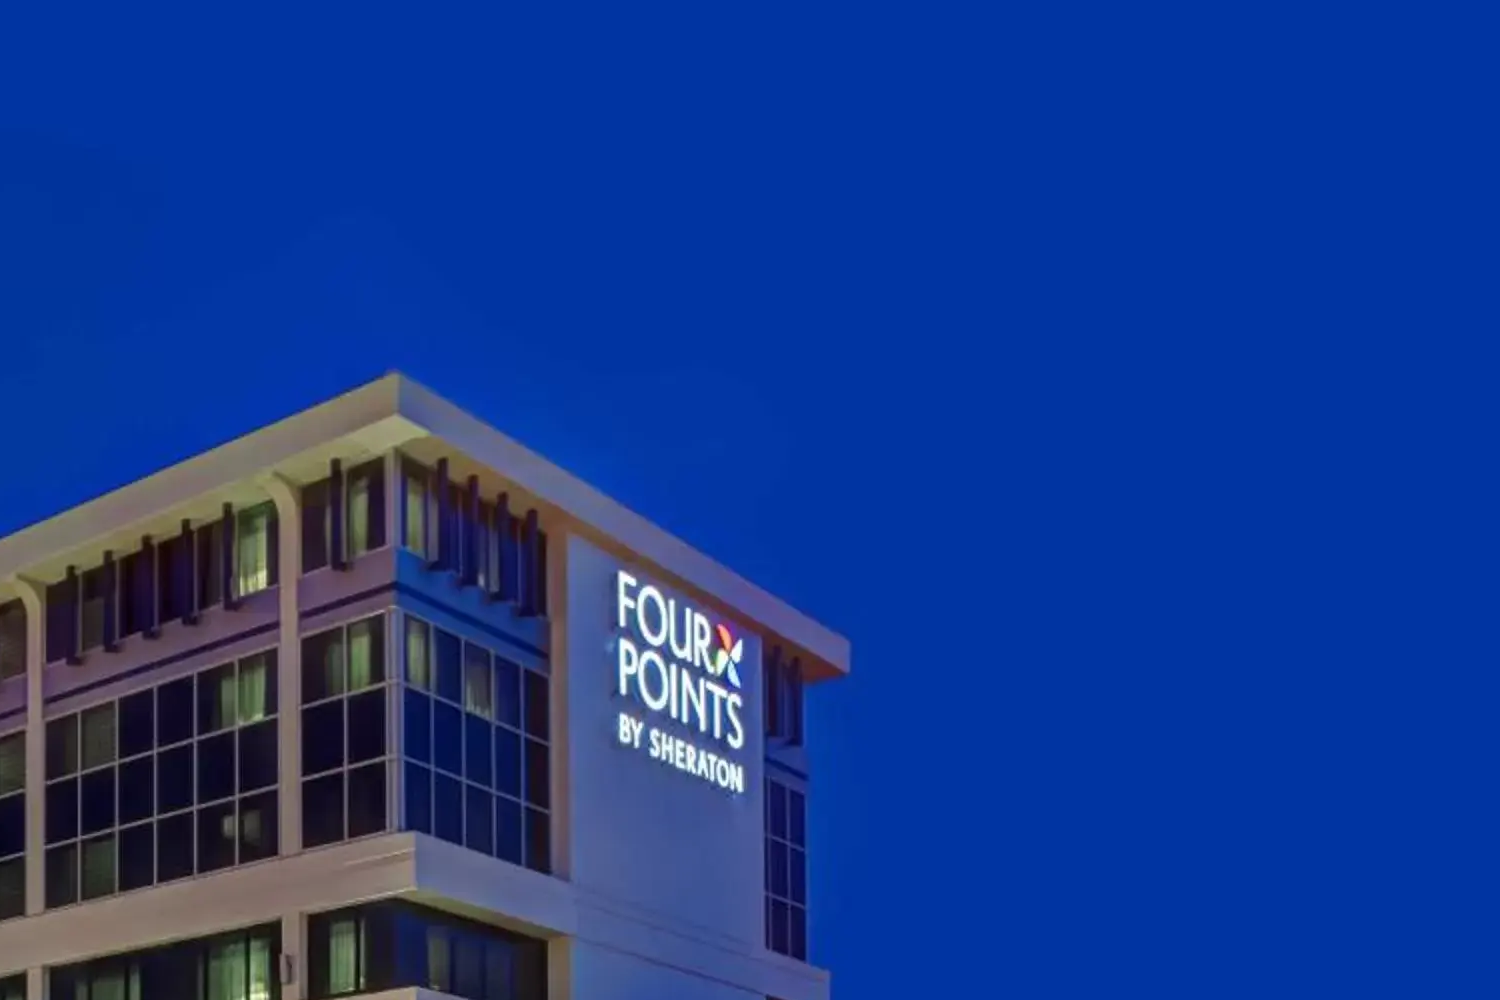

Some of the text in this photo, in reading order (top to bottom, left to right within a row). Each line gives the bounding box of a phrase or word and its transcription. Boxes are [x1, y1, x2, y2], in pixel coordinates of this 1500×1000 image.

[617, 570, 715, 674] FOUR
[618, 637, 744, 749] POINTS
[618, 712, 744, 793] BY SHERATON
